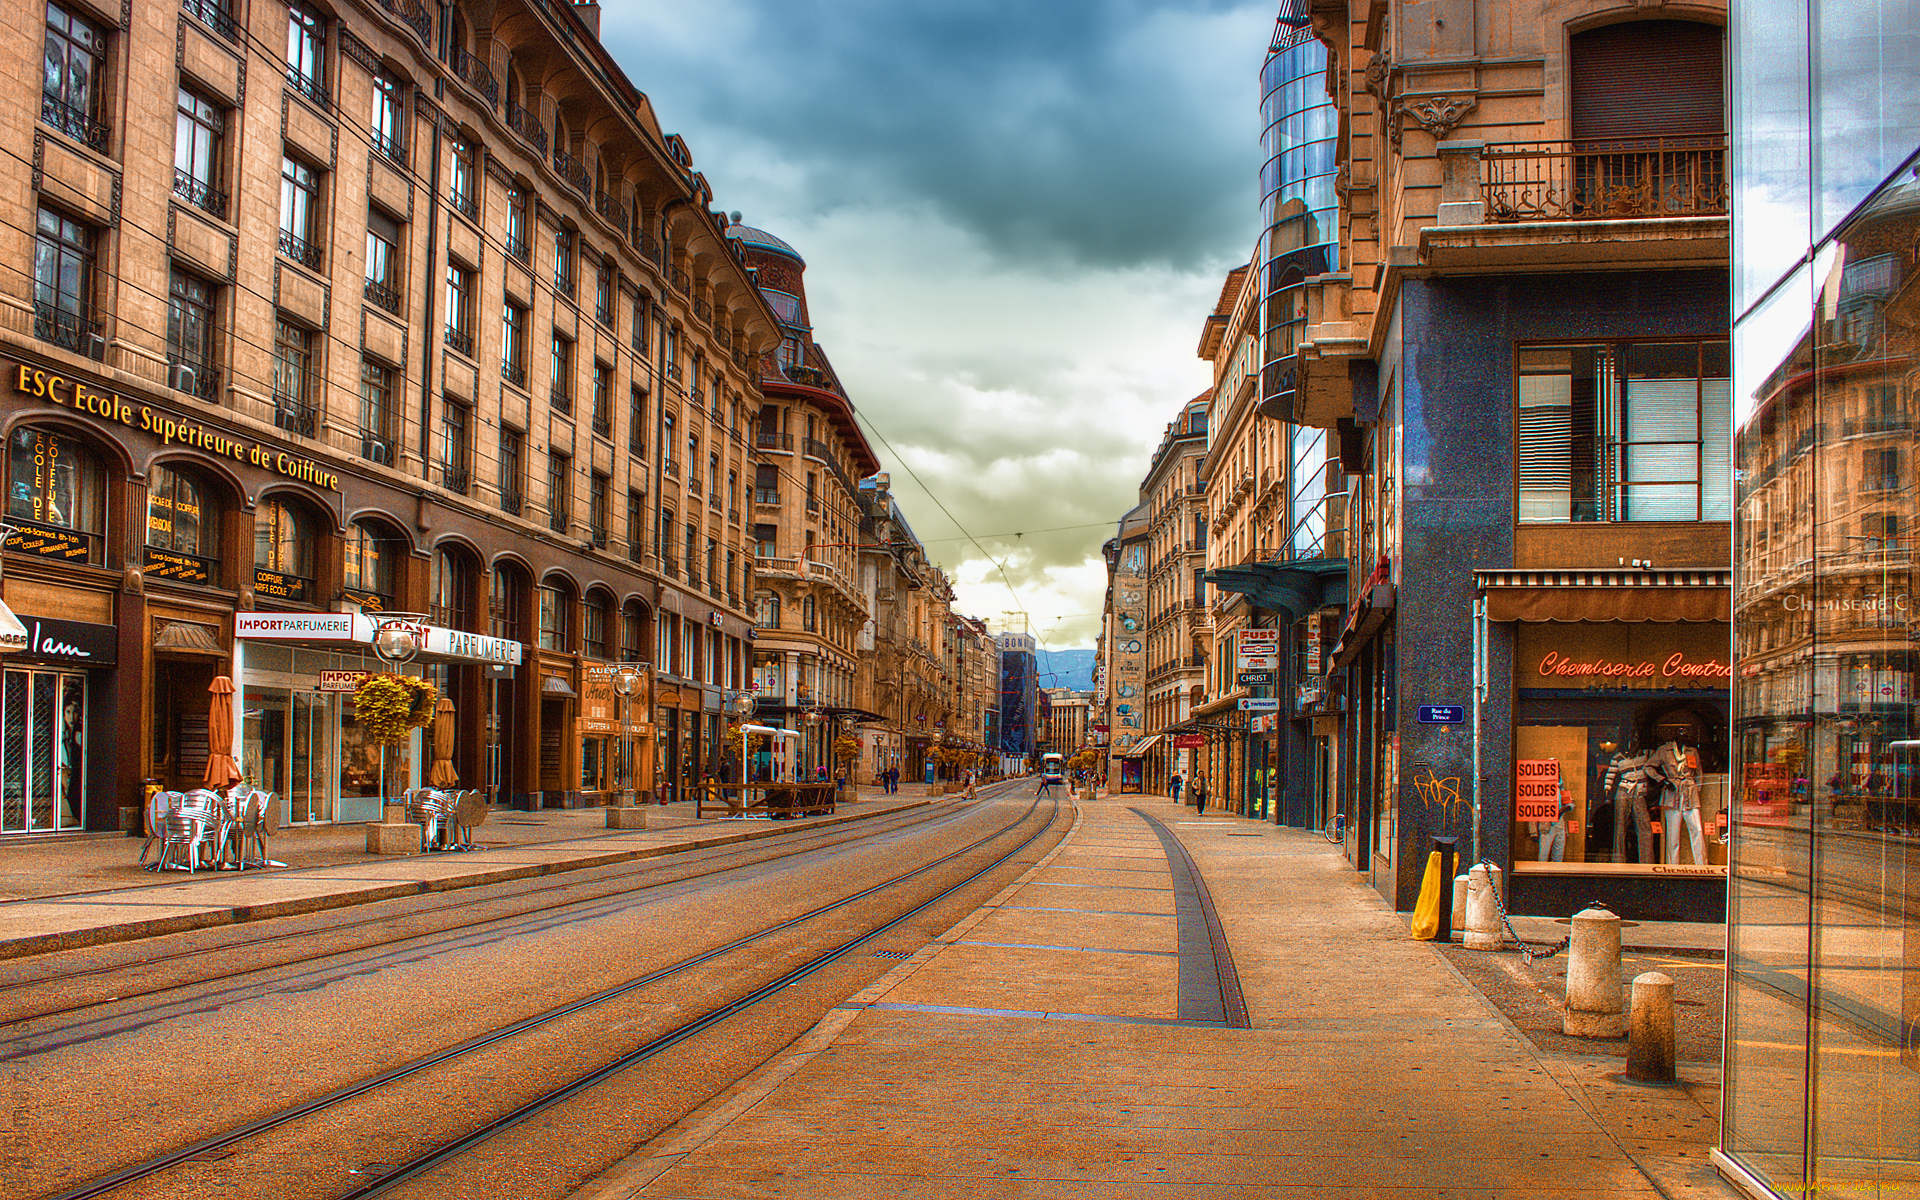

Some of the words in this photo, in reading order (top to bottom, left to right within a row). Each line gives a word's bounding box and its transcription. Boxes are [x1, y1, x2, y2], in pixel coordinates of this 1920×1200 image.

[18, 364, 64, 404] ESC
[74, 383, 132, 425] Ecole
[140, 405, 244, 460] Supérieure
[250, 443, 271, 468] de
[277, 452, 339, 491] Coiffure
[449, 631, 516, 662] PARFUMERIE
[1538, 650, 1656, 678] Chemiserie
[1240, 674, 1268, 682] CHRIST
[1431, 707, 1443, 715] Rue
[1443, 707, 1452, 715] du
[1518, 763, 1557, 777] SOLDES
[1518, 784, 1557, 797] SOLDES
[1518, 804, 1557, 818] SOLDES
